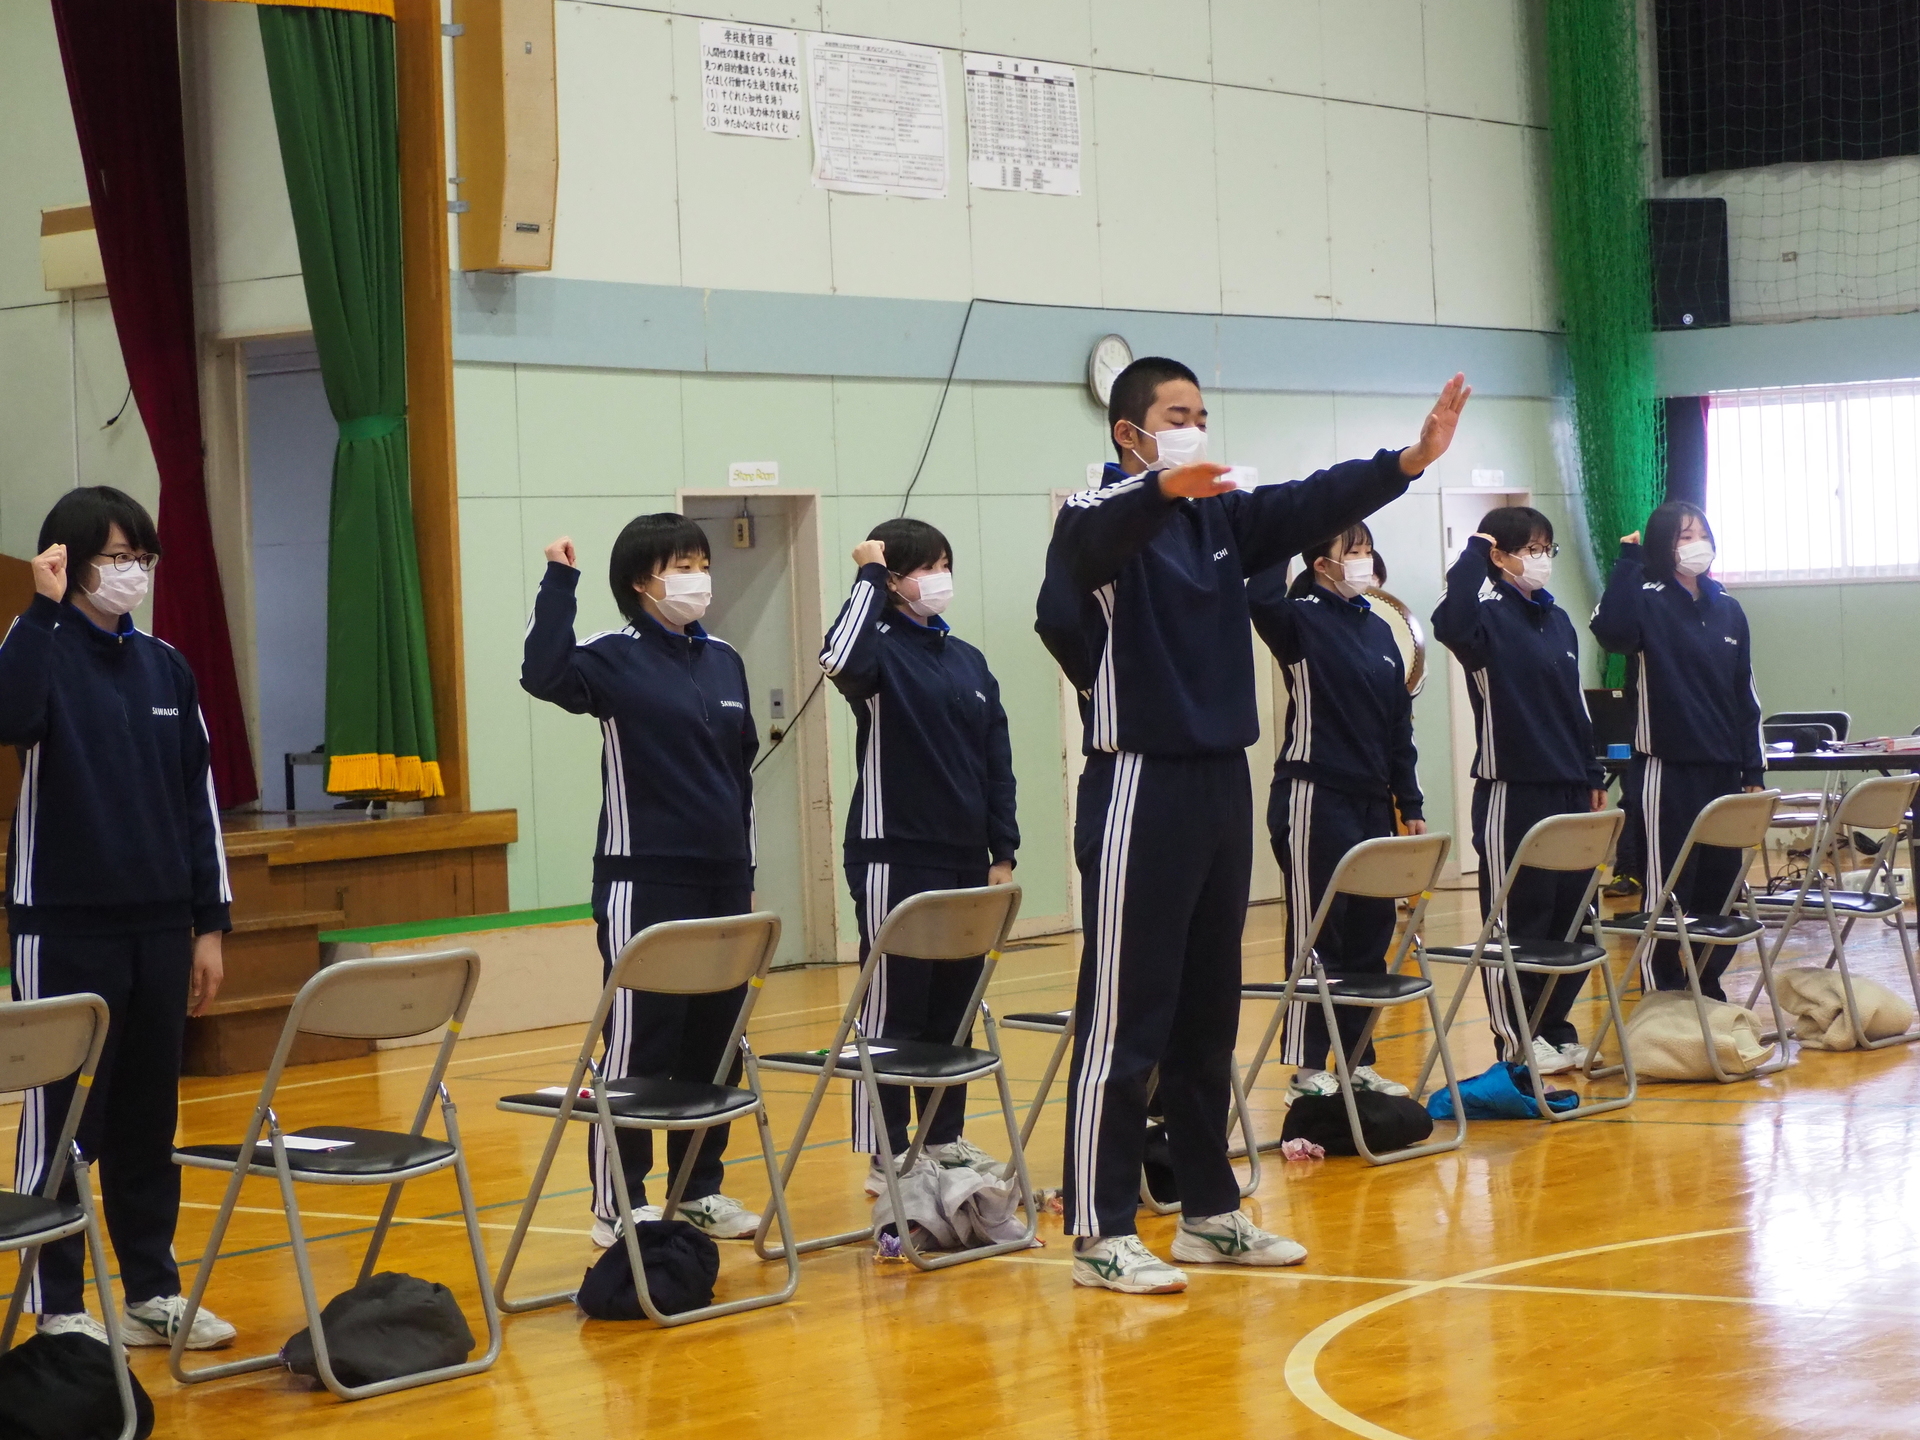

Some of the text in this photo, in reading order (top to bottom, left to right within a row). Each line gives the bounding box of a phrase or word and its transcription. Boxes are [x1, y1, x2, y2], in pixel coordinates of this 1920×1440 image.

[724, 30, 773, 47] 学校教育目標
